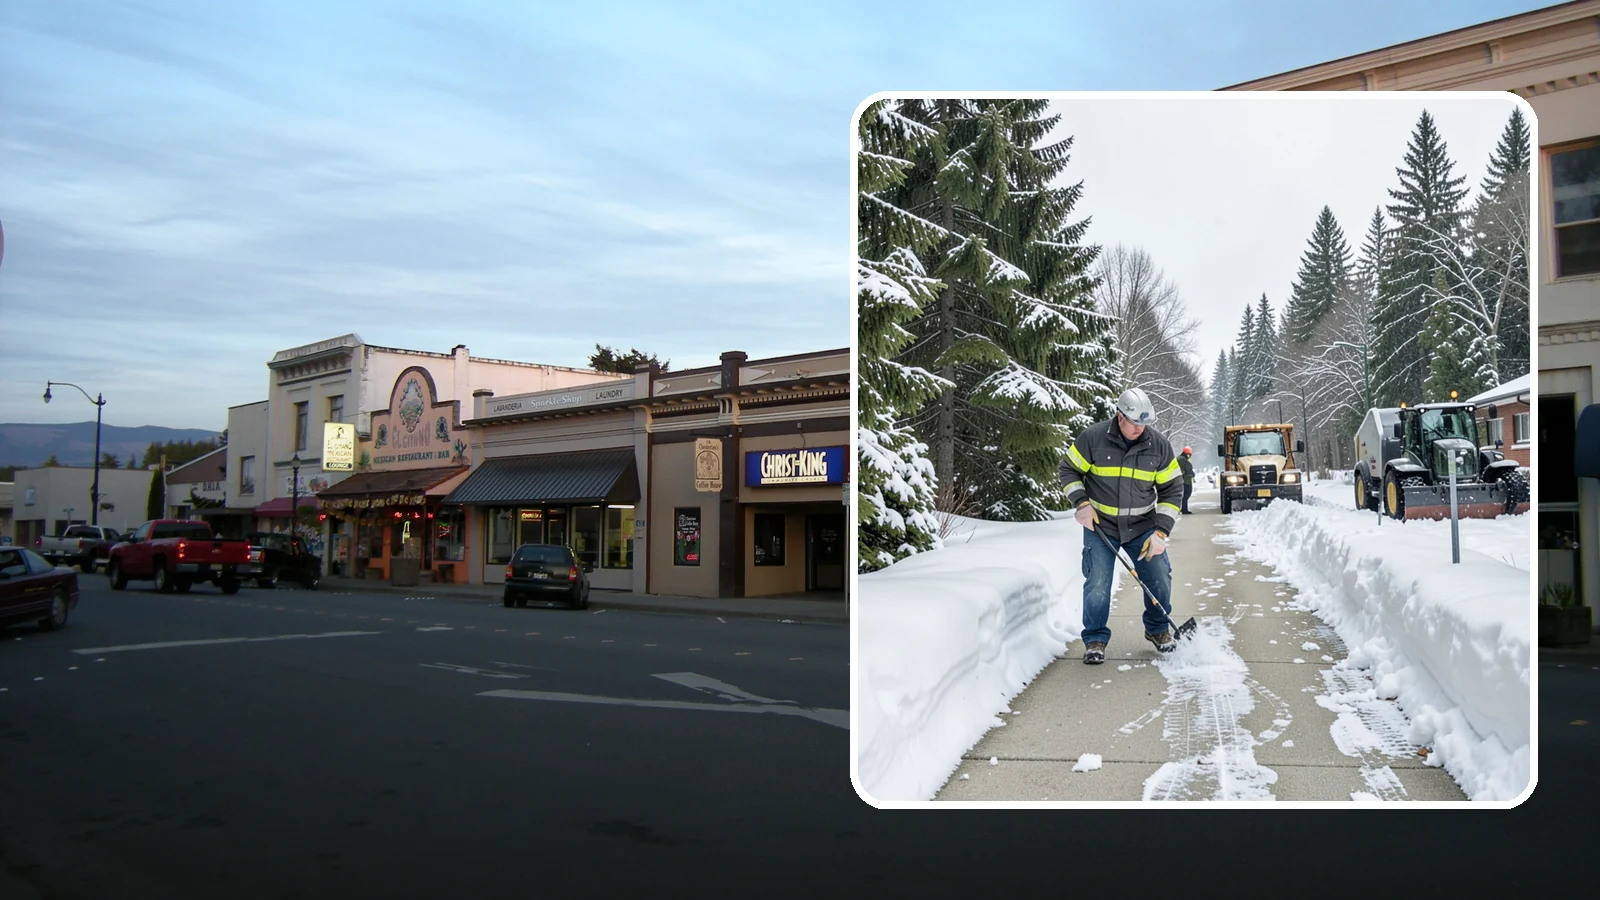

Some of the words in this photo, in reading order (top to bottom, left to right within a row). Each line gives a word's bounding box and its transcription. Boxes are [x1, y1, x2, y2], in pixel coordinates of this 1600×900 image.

[530, 397, 561, 409] Sparkle
[562, 394, 582, 405] Shop
[595, 388, 624, 400] LAUNDRY
[493, 402, 523, 413] LAVANDERIA
[374, 454, 397, 464] MEXICAN
[397, 451, 433, 462] RESTAURANT
[437, 449, 450, 460] BAR
[761, 452, 797, 478] CHRIST
[799, 450, 827, 476] KING
